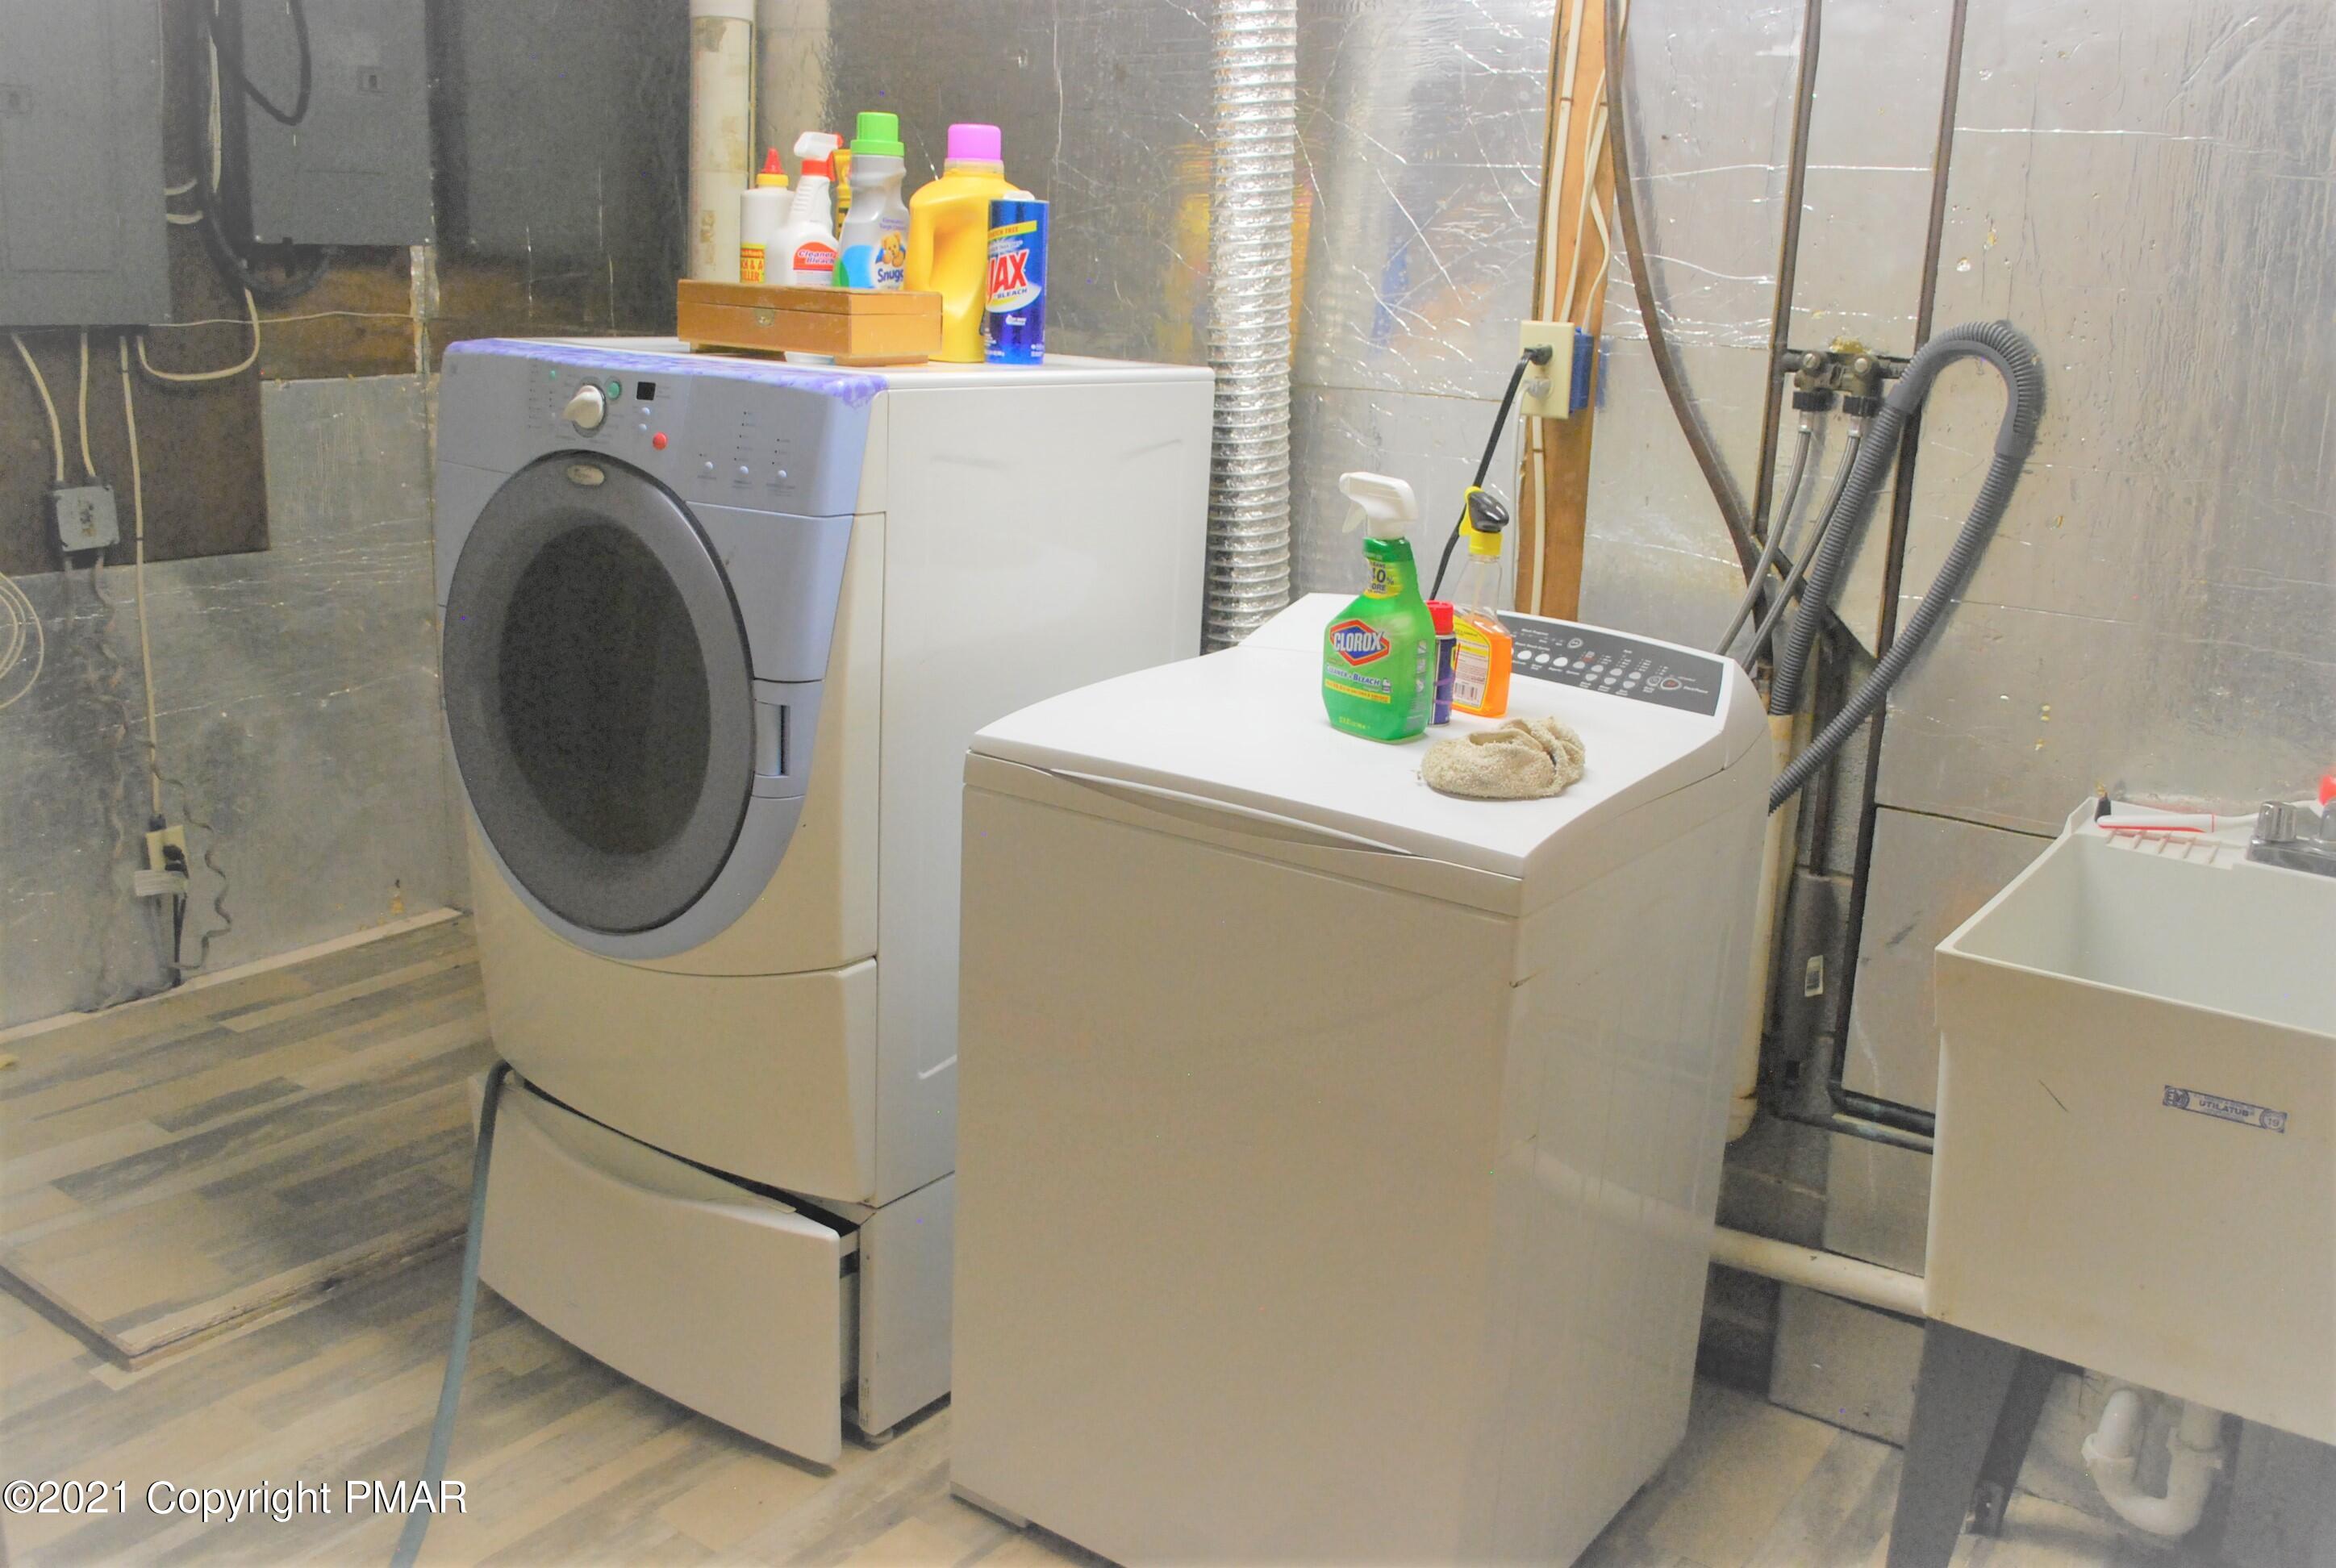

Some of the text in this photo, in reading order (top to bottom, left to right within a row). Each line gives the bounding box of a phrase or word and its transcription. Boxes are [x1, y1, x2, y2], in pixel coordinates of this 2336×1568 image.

[997, 288, 1028, 298] BLEACH
[1333, 632, 1385, 653] CLOROX
[1353, 672, 1381, 686] BLEACH
